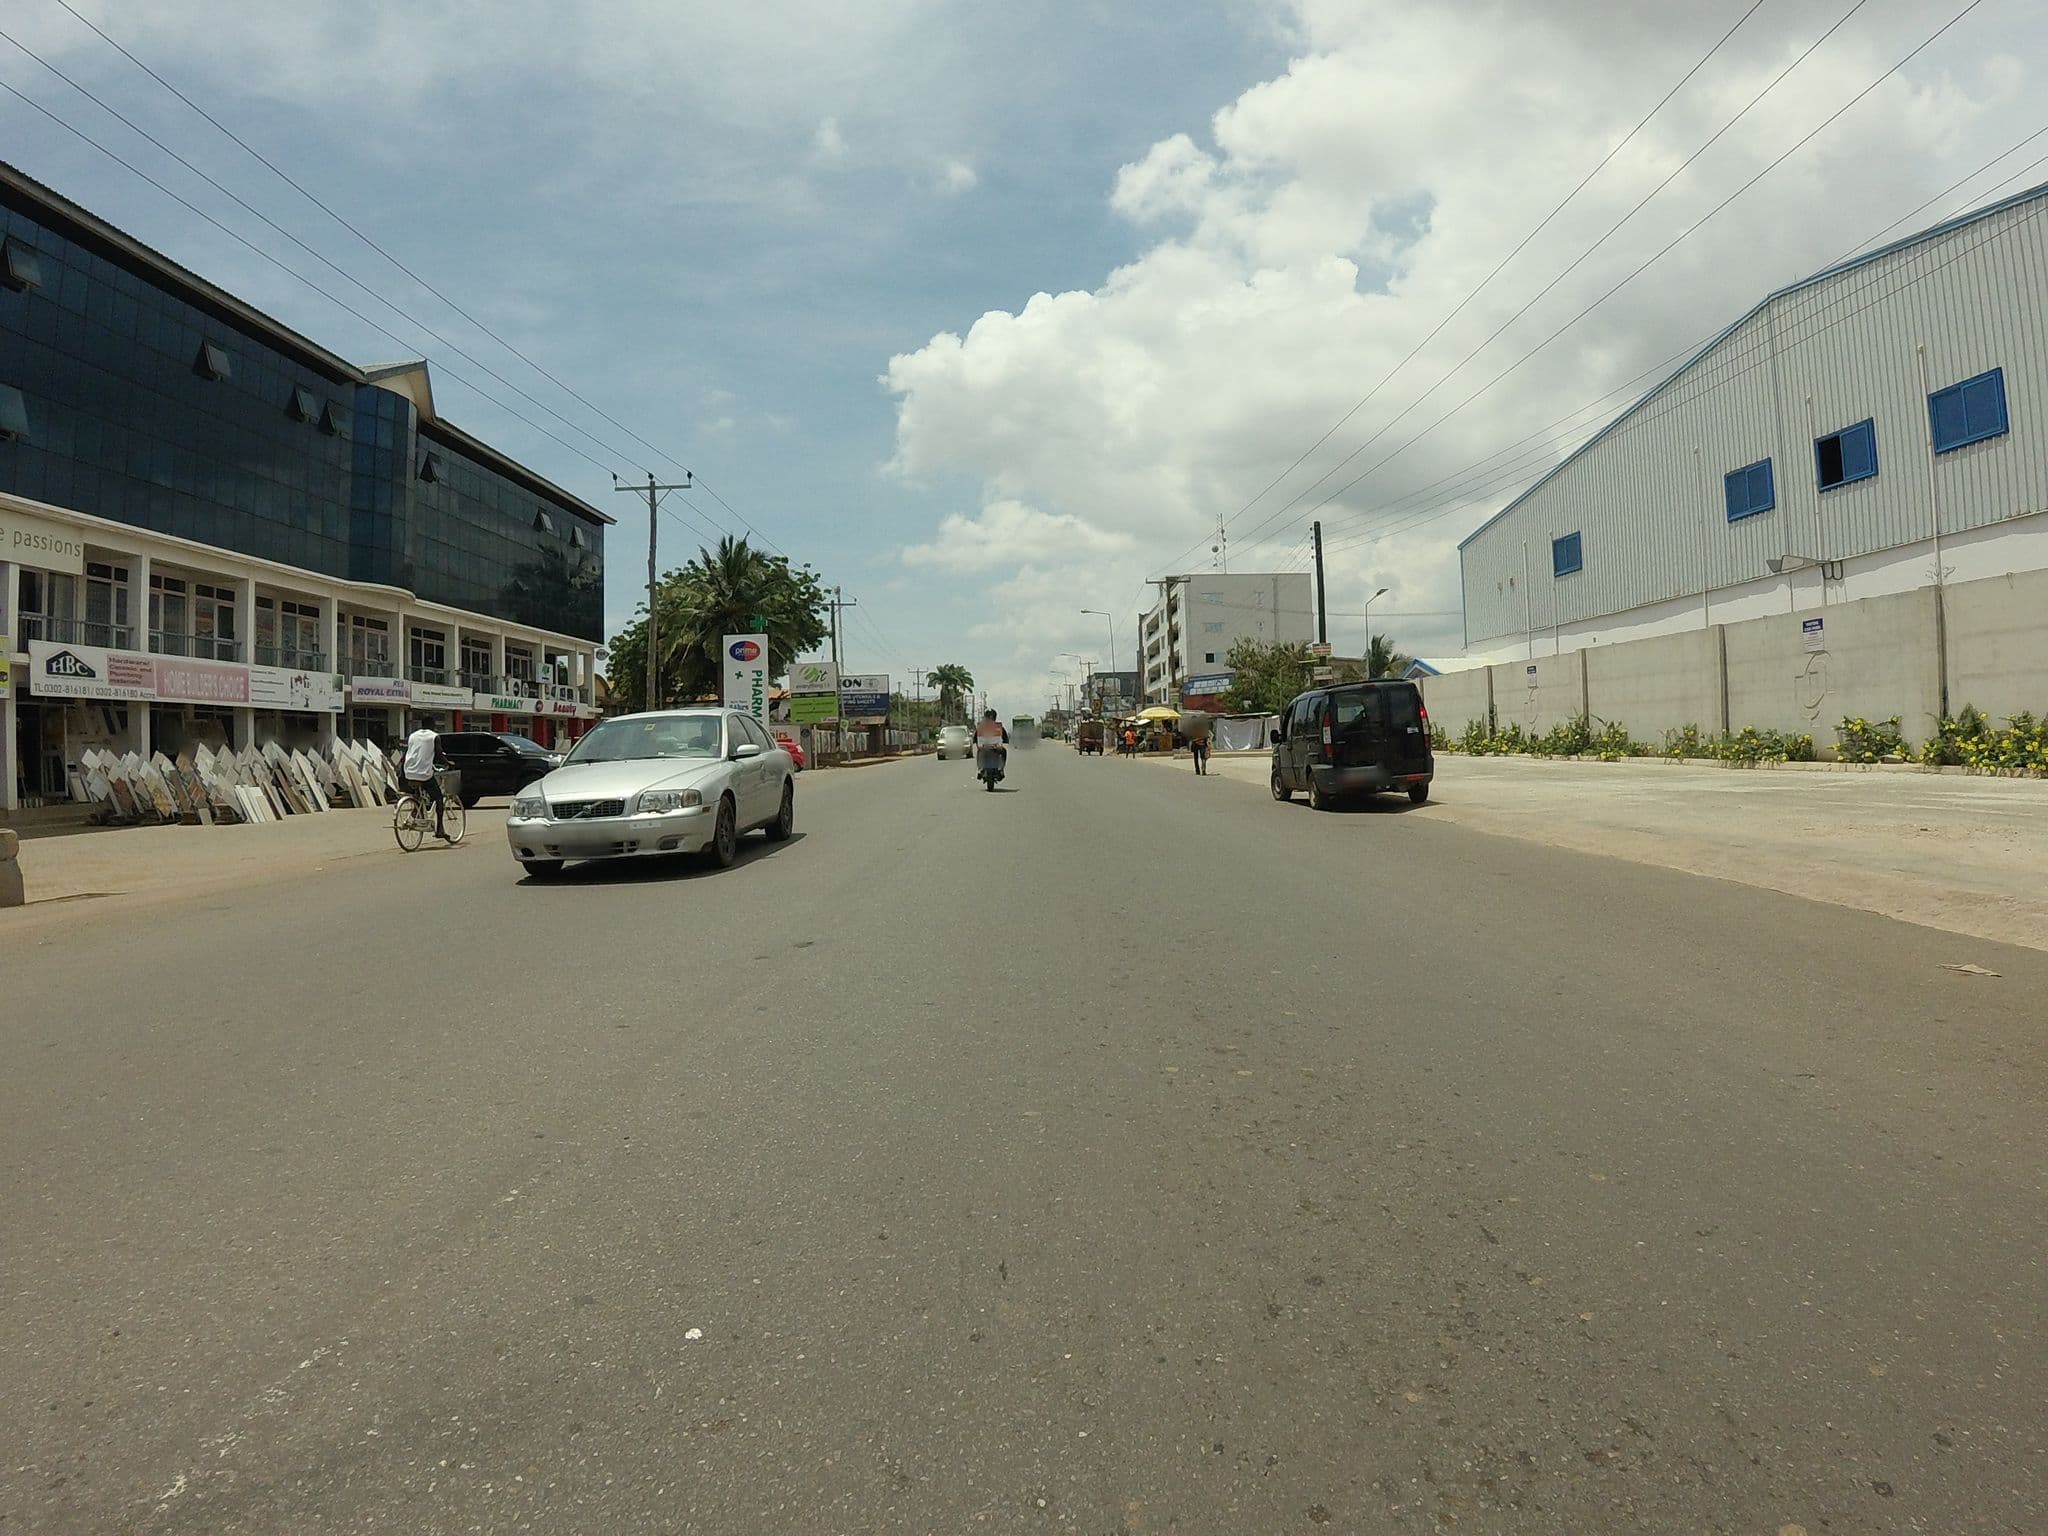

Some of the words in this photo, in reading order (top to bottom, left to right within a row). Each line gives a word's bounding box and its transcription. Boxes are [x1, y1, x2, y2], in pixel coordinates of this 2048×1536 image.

[13, 530, 81, 557] passions
[840, 679, 862, 688] ON
[357, 687, 386, 695] ROYAL
[752, 670, 763, 724] PHARM
[491, 697, 524, 709] PHARMACY
